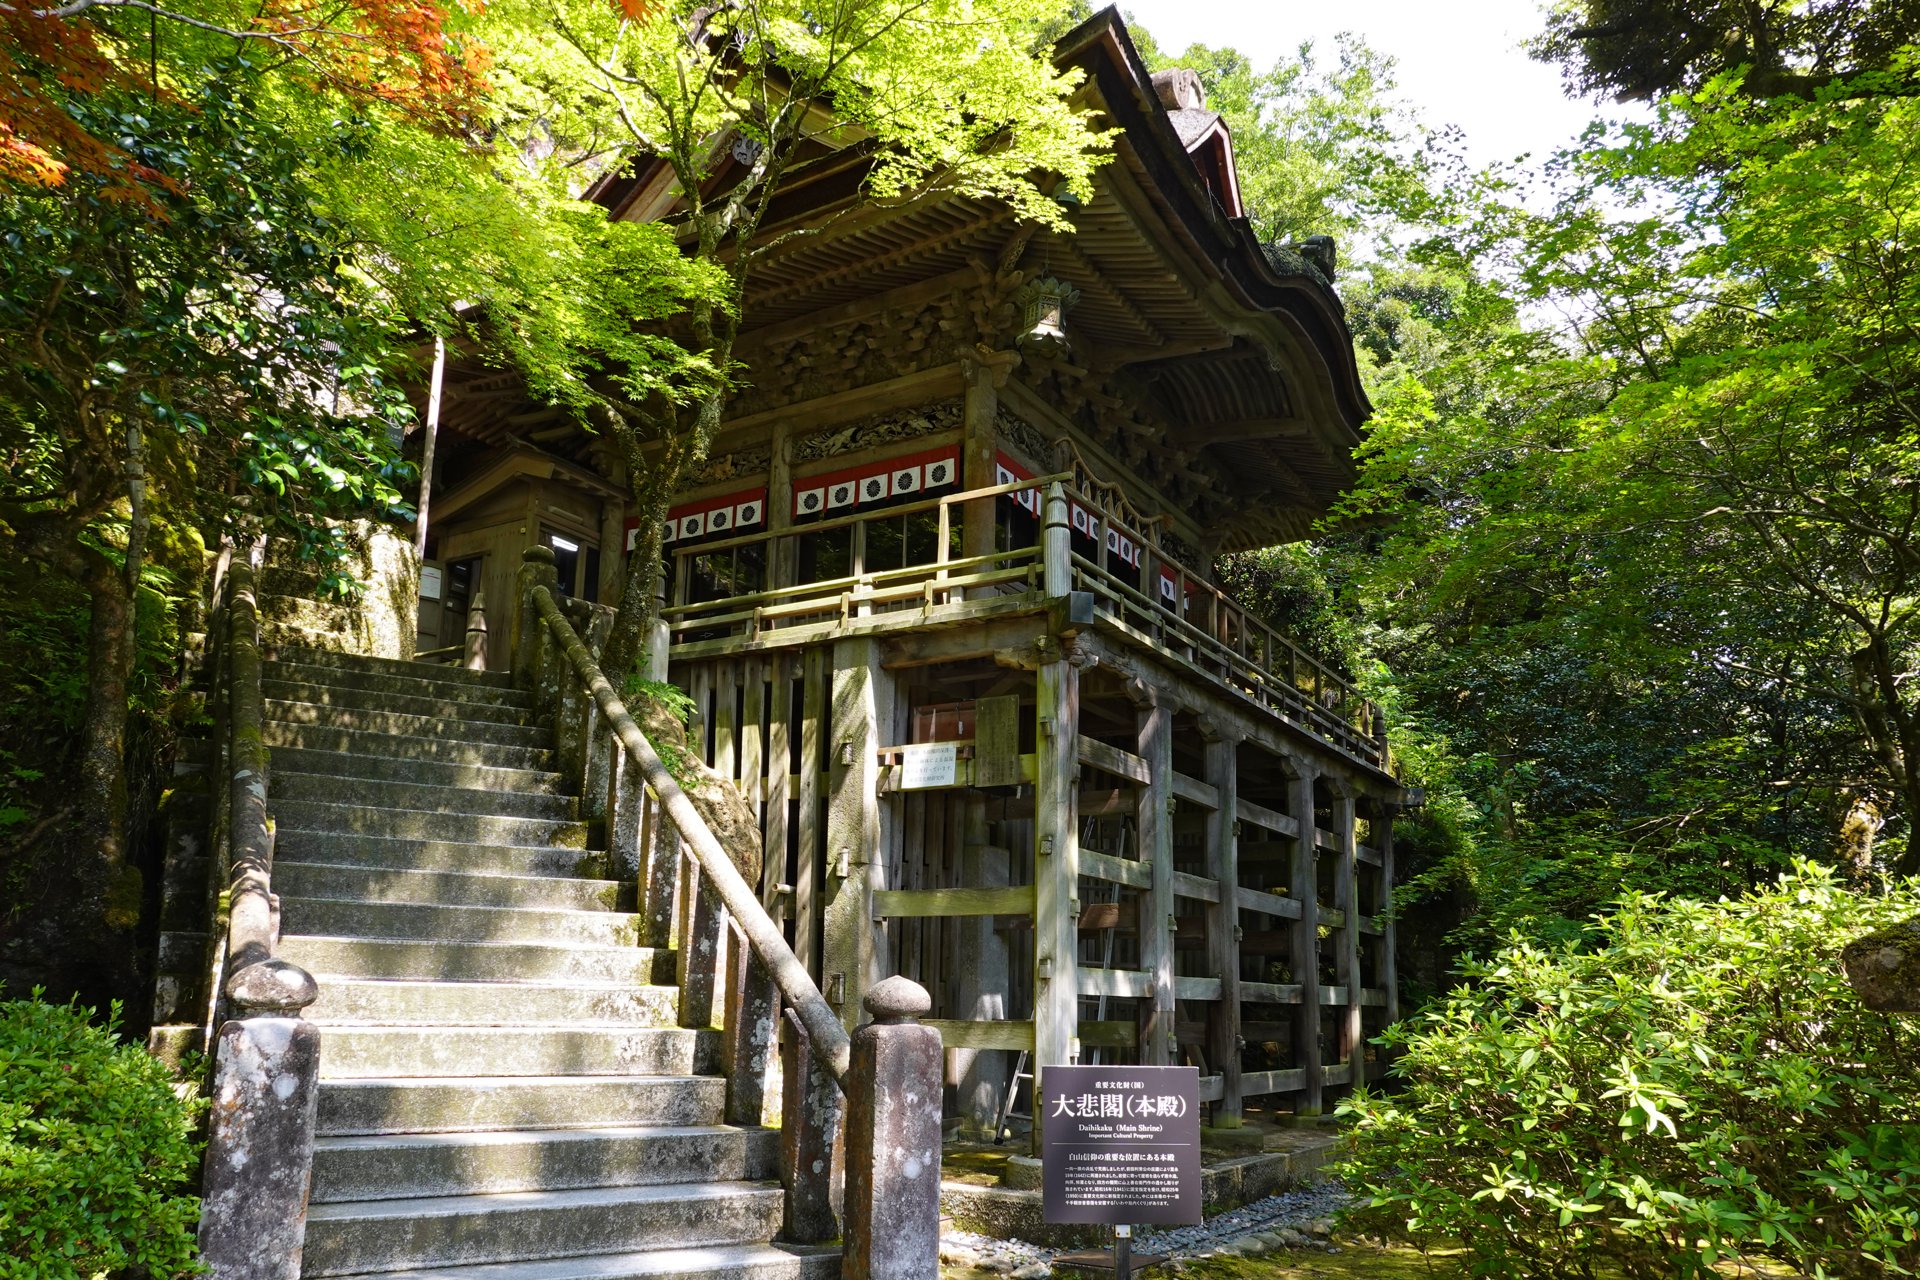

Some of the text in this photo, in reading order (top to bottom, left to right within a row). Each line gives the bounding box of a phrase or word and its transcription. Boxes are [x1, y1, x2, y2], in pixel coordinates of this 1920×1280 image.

[1051, 1093, 1187, 1118] 大悲閣(本殿)
[1116, 1124, 1137, 1132] (Main
[1138, 1124, 1163, 1132] Shrine)
[1069, 1153, 1175, 1161] 白山信仰の重要な位置にある本殿
